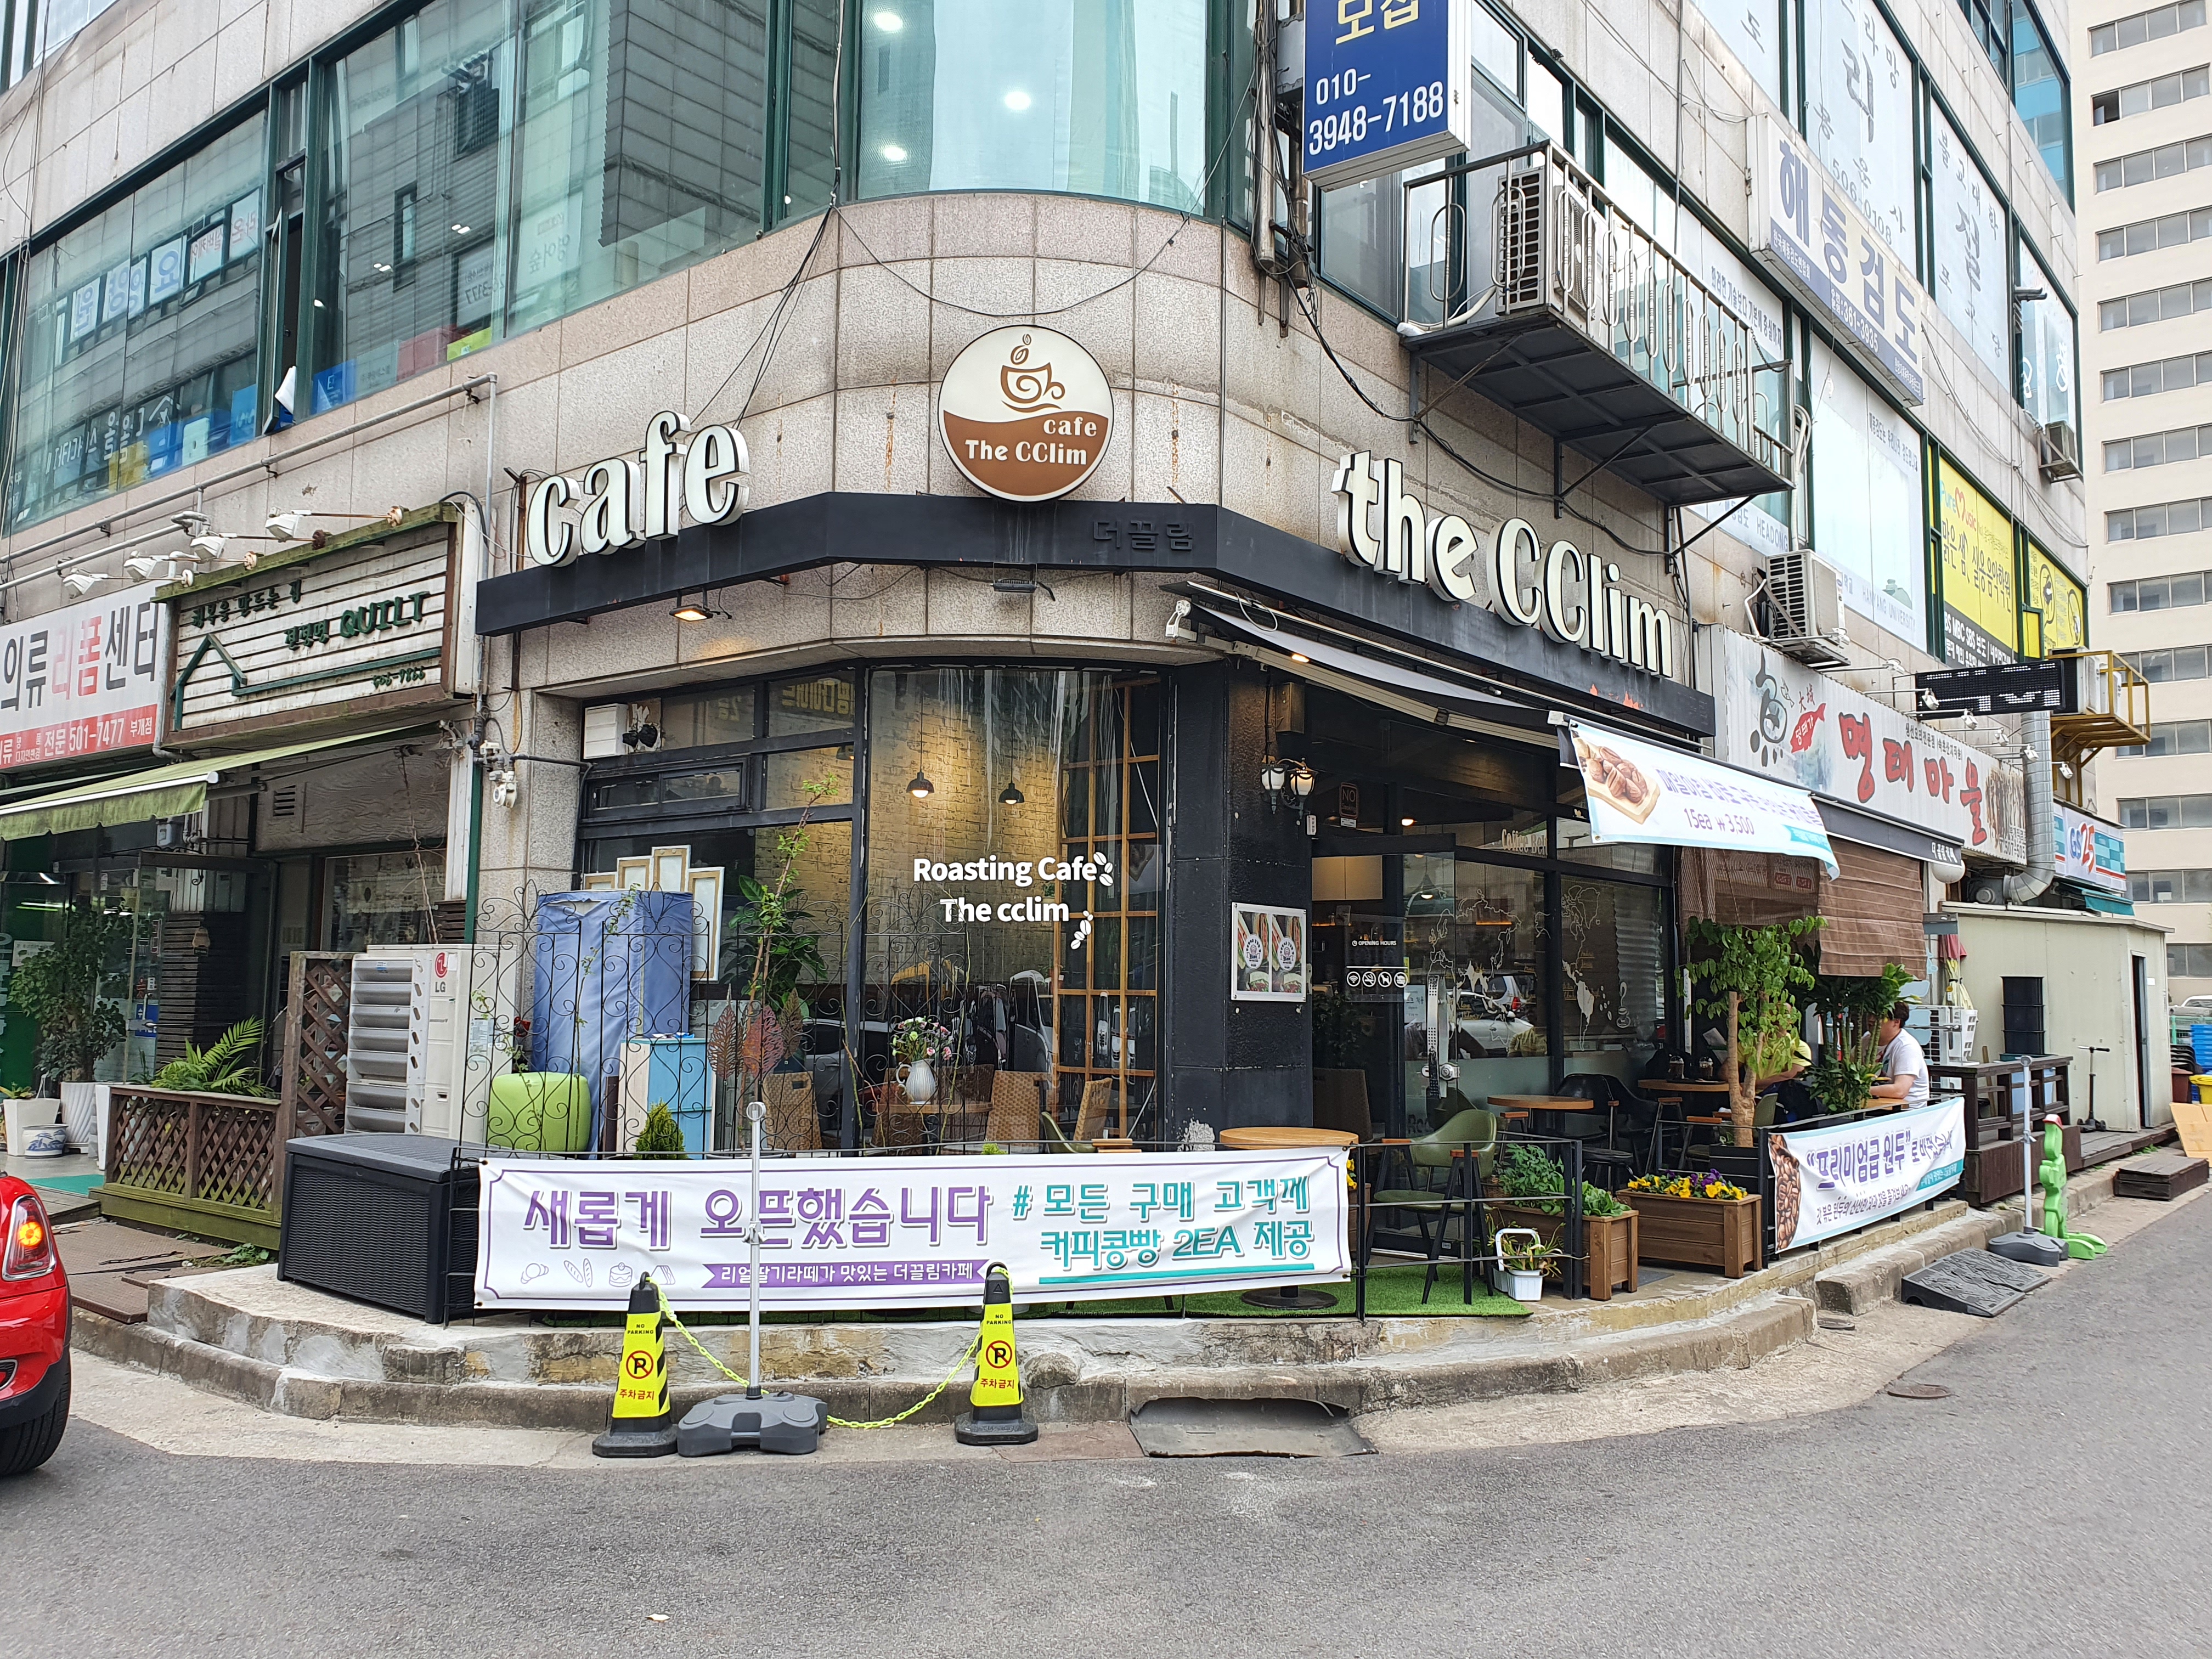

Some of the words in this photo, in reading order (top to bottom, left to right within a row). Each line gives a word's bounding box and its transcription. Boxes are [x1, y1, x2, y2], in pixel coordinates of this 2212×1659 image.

[1316, 68, 1371, 105] 010-
[1308, 81, 1444, 155] 3948-7188
[1779, 138, 1918, 364] 해동검도
[1043, 415, 1097, 437] cafe
[964, 439, 1008, 462] The
[1014, 441, 1087, 465] CClim
[527, 410, 749, 567] cafe
[1092, 520, 1193, 551] 더끌림
[1756, 516, 1788, 552] HEADONG
[1330, 450, 1479, 602] the
[1487, 517, 1673, 679] CClim
[1972, 547, 2012, 614] 실용음악학원
[340, 591, 431, 638] QUILT
[1889, 602, 1916, 632] UNIVERSITY
[1952, 616, 1965, 642] MBC
[1966, 626, 1976, 650] SBS
[0, 603, 159, 711] 의류리폼센터
[44, 728, 66, 757] 전문
[69, 718, 125, 752] 501-7477
[129, 716, 153, 738] 부개점
[1342, 789, 1356, 803] NO
[1838, 712, 1988, 846] 명태마을
[1684, 808, 1713, 830] 15ea
[1502, 829, 1528, 853] Coffee
[2070, 823, 2095, 873] GS25
[913, 855, 1032, 887] Roasting
[1037, 856, 1097, 882] Cafe
[940, 898, 992, 922] The
[997, 896, 1069, 923] cclim
[435, 981, 446, 993] LG
[523, 1189, 672, 1251] 새롭게
[700, 1186, 994, 1249] 오픈했습니다
[1129, 1181, 1195, 1222] 구매
[1040, 1224, 1164, 1271] 커피콩빵
[1171, 1225, 1245, 1261] 2EA
[1253, 1220, 1314, 1259] 제공
[840, 1264, 888, 1283] 맛있는
[894, 1262, 973, 1281] 더끌림카페
[619, 1389, 654, 1401] 주차금지
[980, 1378, 1015, 1389] 주차금지
